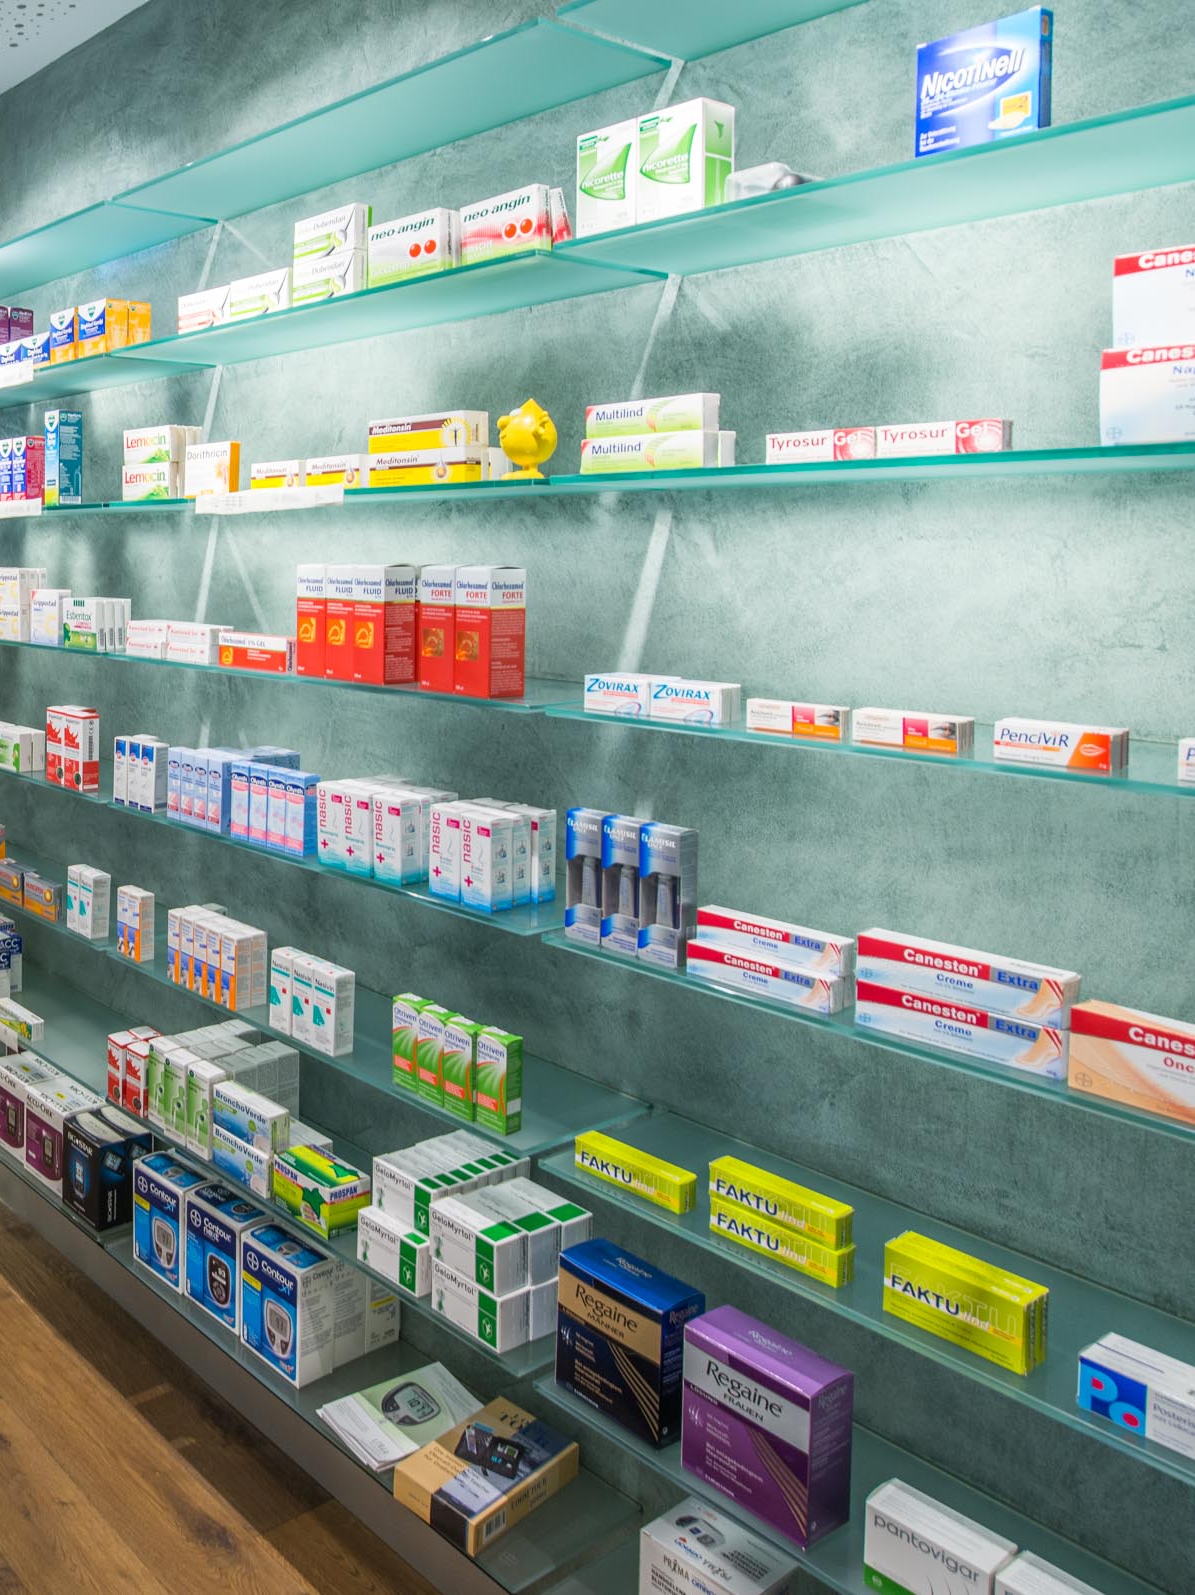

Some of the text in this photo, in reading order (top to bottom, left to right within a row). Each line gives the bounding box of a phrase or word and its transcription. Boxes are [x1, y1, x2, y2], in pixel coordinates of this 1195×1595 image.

[642, 153, 689, 172] nicorette
[581, 171, 624, 188] nicorette
[463, 194, 531, 223] neo angin
[371, 216, 435, 242] neo angin
[1138, 249, 1195, 270] Cane
[595, 406, 644, 421] Multilind
[126, 433, 166, 450] Lemocin
[769, 430, 860, 451] Tyrosur Gel
[881, 422, 989, 443] Tyrosur Gel
[187, 448, 228, 461] Dorithricin
[591, 441, 641, 455] Multilind
[376, 455, 418, 466] Meditonsin
[124, 469, 166, 485] Lemocin
[306, 585, 323, 593] FLUID
[335, 586, 353, 594] FLUID
[363, 587, 382, 595] FLUID
[394, 587, 414, 595] FLUID
[421, 579, 453, 589] Chlorhexamed
[457, 581, 488, 591] Chlorhexamed
[492, 580, 524, 591] Chlorhexamed
[431, 590, 453, 598] FORTE
[466, 591, 488, 600] FORTE
[502, 591, 524, 600] FORTE
[587, 678, 640, 693] ZOVIRAX
[653, 684, 711, 700] ZOVIRAX
[344, 795, 352, 835] nasic
[375, 801, 383, 841] nasic
[432, 812, 441, 854] nasic
[463, 819, 471, 863] nasic
[733, 920, 822, 950] Canesten Extra
[753, 937, 779, 949] Creme
[272, 959, 290, 971] Nasivin
[724, 955, 811, 986] Canesten Extra
[903, 948, 1039, 990] Canesten Extra
[294, 969, 312, 982] Nasivin
[315, 978, 335, 992] Nasivin
[743, 972, 769, 985] Creme
[936, 973, 974, 990] Creme
[394, 1005, 417, 1022] Otriven
[901, 994, 1037, 1039] Canesten Extra
[419, 1017, 443, 1034] Otriven
[935, 1020, 972, 1037] Creme
[445, 1030, 470, 1047] Otriven
[477, 1040, 505, 1059] Otriven
[215, 1089, 267, 1124] BronchoVerde
[214, 1128, 264, 1165] BronchoVerde
[274, 1159, 298, 1182] PROSPAN
[375, 1164, 411, 1191] GeloMyrtol
[581, 1150, 655, 1195] FAKTU lind
[149, 1183, 177, 1206] Contour
[330, 1185, 358, 1201] PROSPAN
[716, 1178, 805, 1229] FAKTU lind
[203, 1217, 232, 1242] Contour
[360, 1216, 397, 1244] GeloMyrtol
[432, 1211, 472, 1241] GeloMyrtol
[717, 1212, 807, 1265] FAKTU lind
[261, 1260, 294, 1291] Contour
[434, 1264, 477, 1296] GeloMyrtol
[576, 1283, 638, 1333] Regaine
[891, 1274, 960, 1316] FAKTU
[962, 1311, 990, 1332] lind
[706, 1359, 783, 1419] Regaine
[723, 1394, 764, 1423] FRAUEN
[873, 1511, 980, 1584] pantovigar
